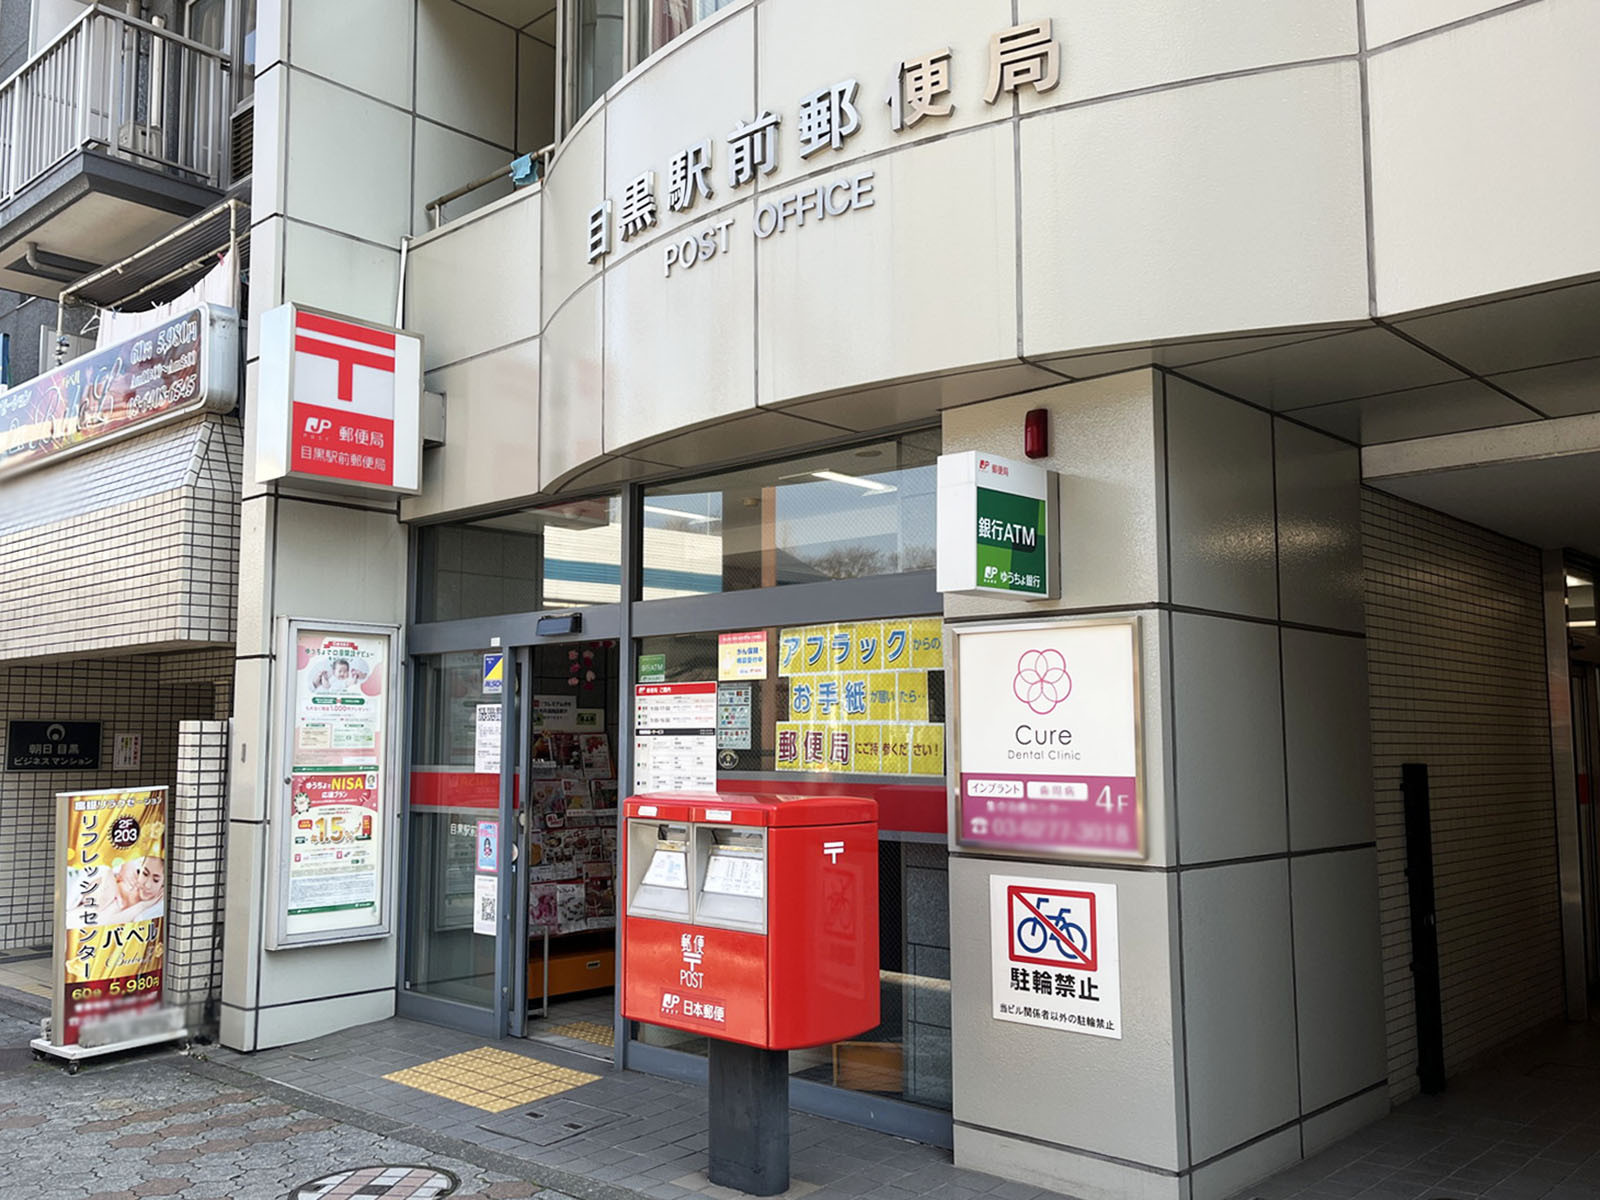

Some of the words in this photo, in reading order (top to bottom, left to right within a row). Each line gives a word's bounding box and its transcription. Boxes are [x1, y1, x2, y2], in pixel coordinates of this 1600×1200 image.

[587, 18, 1061, 265] 目黒駅前郵便局
[664, 218, 734, 277] POST
[752, 171, 876, 239] OFFICE
[339, 426, 384, 448] 郵便局
[301, 445, 386, 471] 目黒駅前郵便局
[978, 517, 1036, 547] 銀行ATM
[1000, 570, 1041, 588] ゆうちょ銀行
[1015, 724, 1072, 745] Cure
[1007, 750, 1044, 760] Dental
[1048, 750, 1081, 761] Clinic
[971, 782, 1021, 794] インプラント
[119, 819, 132, 828] 2F
[114, 829, 137, 842] 203
[79, 815, 98, 979] リフレッシュセンター
[103, 922, 157, 948] バベル
[681, 933, 705, 954] 郵便
[680, 969, 704, 989] POST
[1010, 967, 1100, 1002] 駐輪禁止
[683, 1000, 725, 1022] 日本郵便
[1000, 1003, 1116, 1030] 当ビル関係者以外の駐輪禁止
